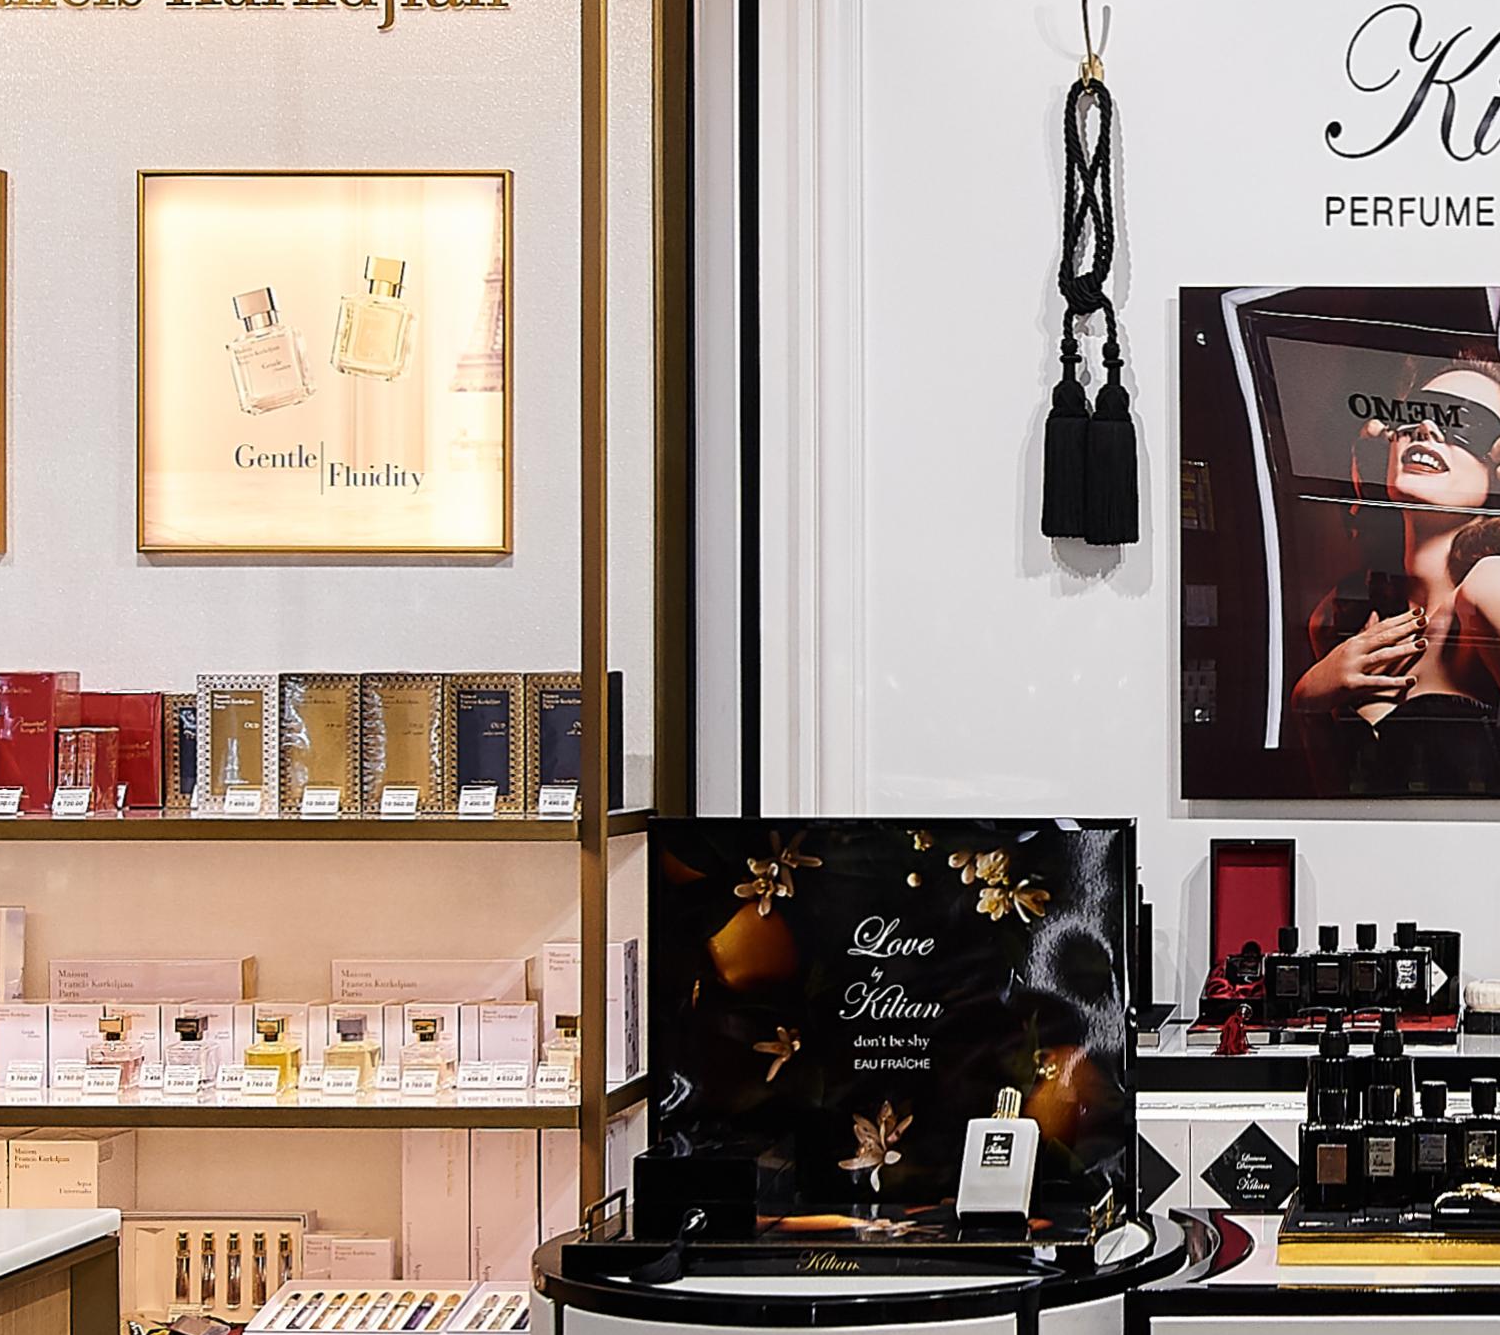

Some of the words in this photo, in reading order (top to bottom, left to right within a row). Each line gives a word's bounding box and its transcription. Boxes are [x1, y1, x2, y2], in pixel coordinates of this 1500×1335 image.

[1324, 195, 1496, 228] PERFUME
[235, 444, 318, 469] Gentle
[329, 463, 425, 495] Fluidity
[846, 915, 936, 958] Love
[838, 981, 945, 1020] Kilian
[853, 1034, 887, 1048] don't
[890, 1034, 906, 1048] be
[907, 1034, 931, 1050] shy
[854, 1058, 878, 1070] EAU
[796, 1250, 860, 1272] Kilian
